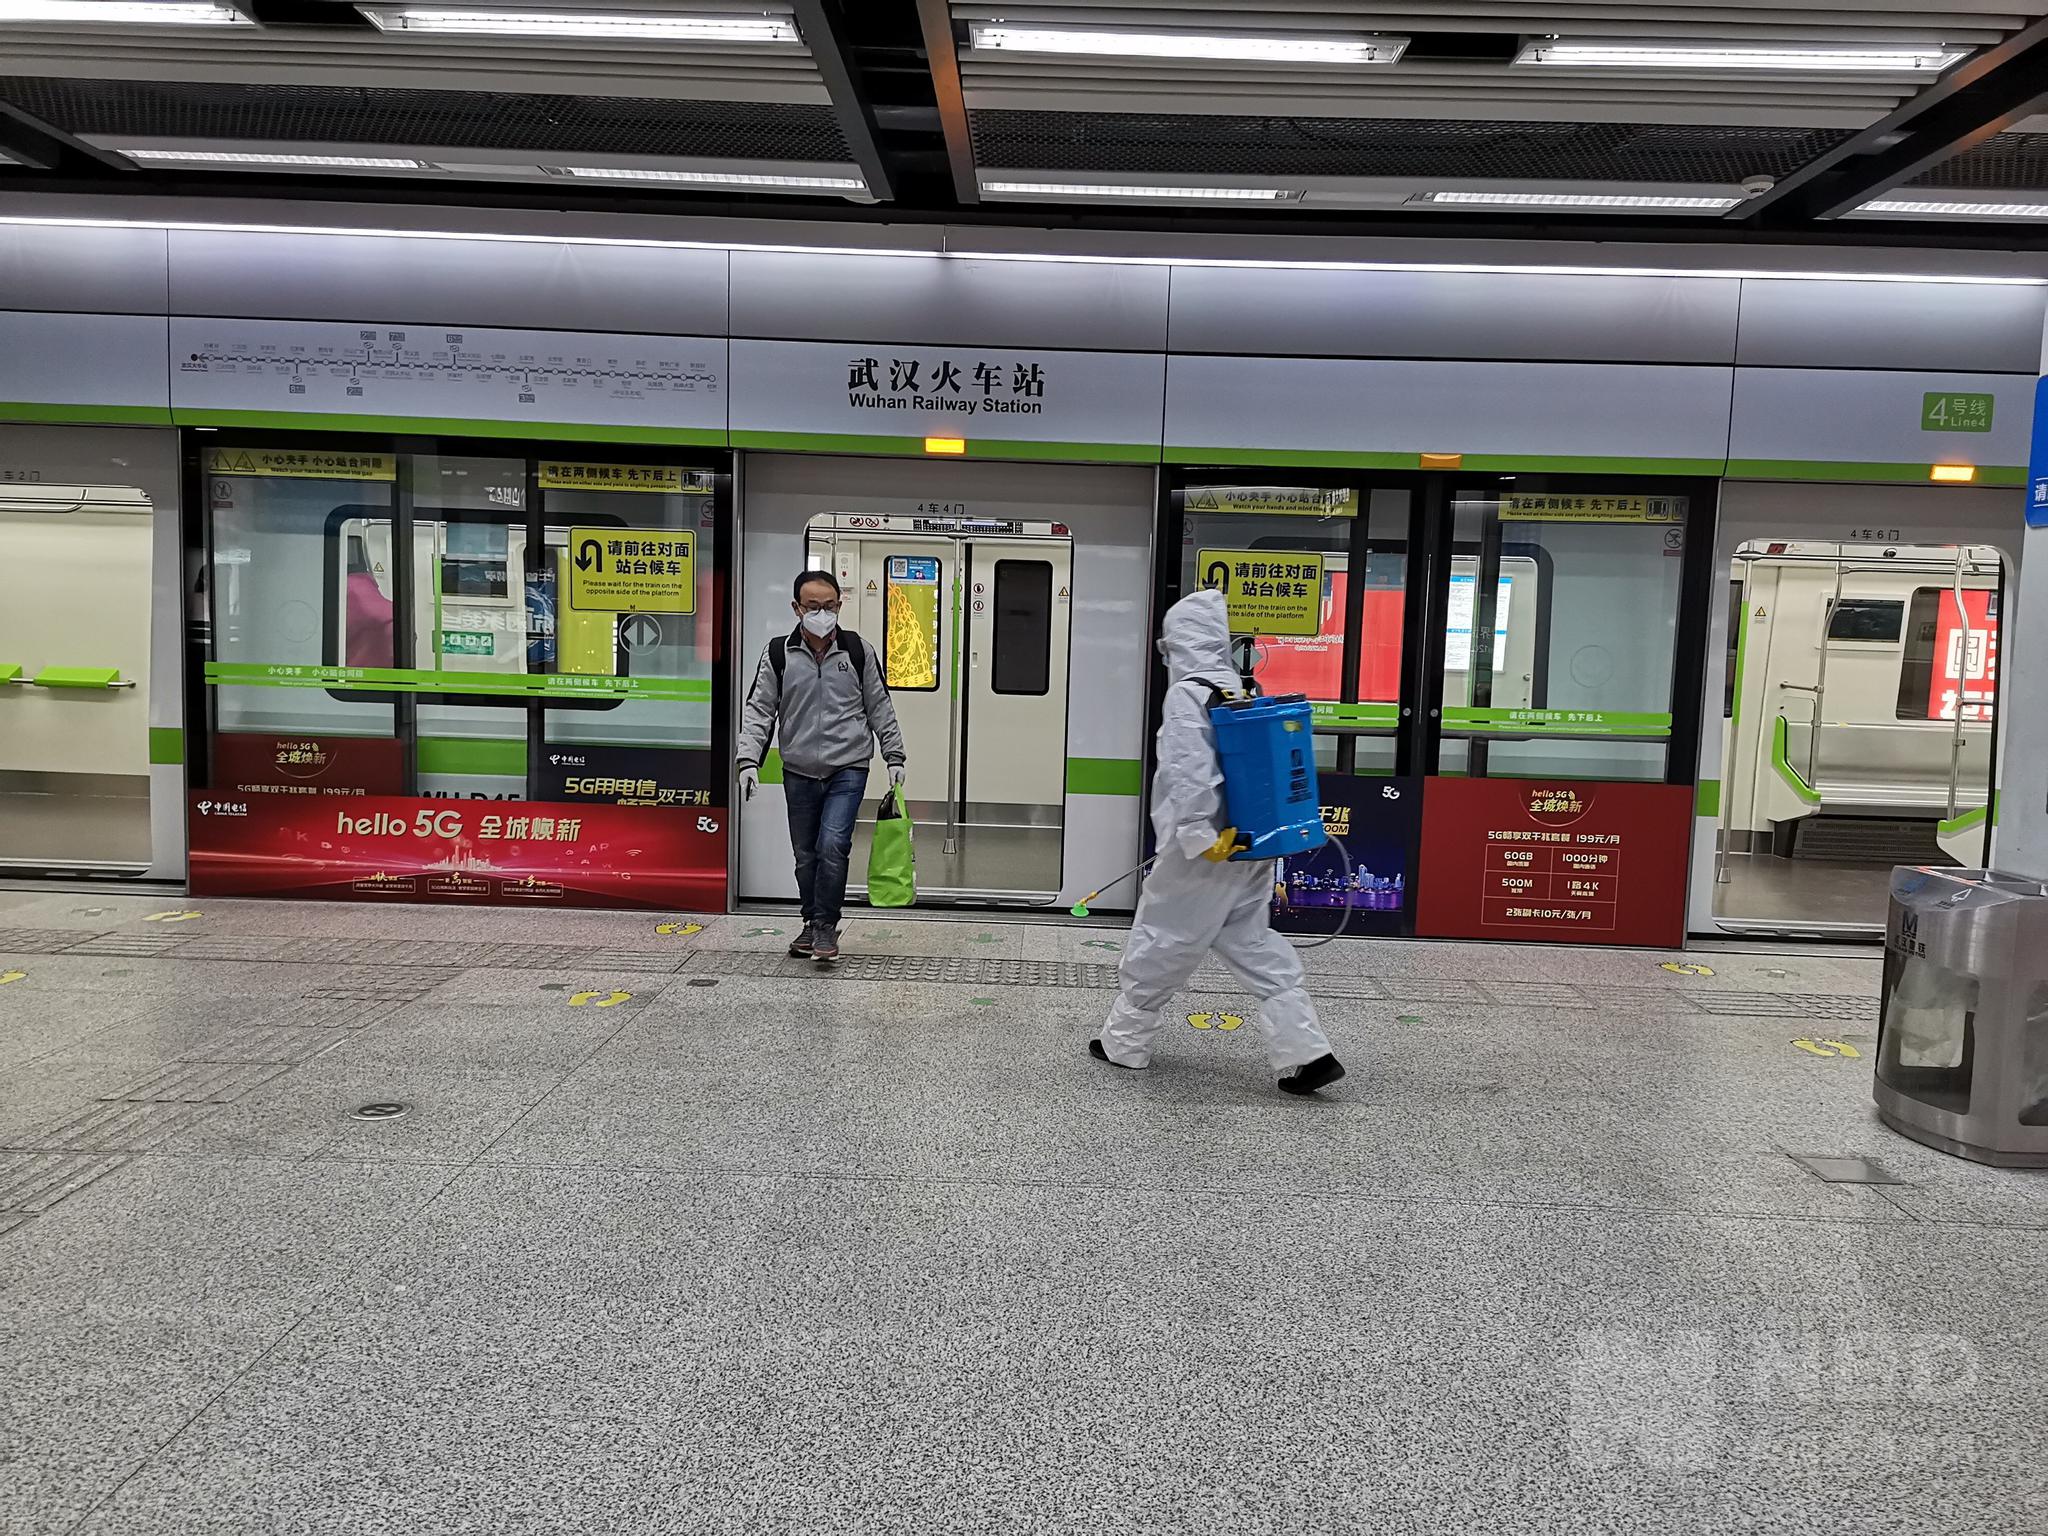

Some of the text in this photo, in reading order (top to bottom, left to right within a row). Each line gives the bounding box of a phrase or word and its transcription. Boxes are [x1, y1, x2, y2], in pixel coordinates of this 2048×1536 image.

[848, 358, 1045, 397] 武汉火车站
[849, 393, 1042, 415] Wuhan Railway Station
[1928, 397, 1986, 426] 4号线
[628, 468, 677, 482] 先下后上
[1590, 499, 1642, 511] 先下后上
[607, 540, 690, 558] 请前往对面
[615, 559, 681, 576] 站台候车
[1235, 562, 1317, 580] 请前往对面
[583, 579, 606, 587] Please
[1242, 581, 1308, 598] 站台候车
[651, 589, 680, 597] platform
[276, 742, 298, 750] hello
[275, 750, 327, 765] 全城焕新
[564, 777, 657, 797] 5G用电信
[658, 788, 711, 805] 双千兆
[1382, 785, 1401, 800] 5G
[1531, 789, 1567, 798] hello 5G
[214, 801, 247, 812] 中国电信
[1529, 797, 1583, 813] 全城焕新
[337, 809, 463, 838] hello 5G
[478, 815, 582, 843] 全城焕新
[696, 816, 718, 833] 5G
[1576, 834, 1620, 844] 199元/月
[1504, 851, 1534, 860] 60GB
[1562, 853, 1608, 864] 1000分钟
[1502, 878, 1533, 888] 500M
